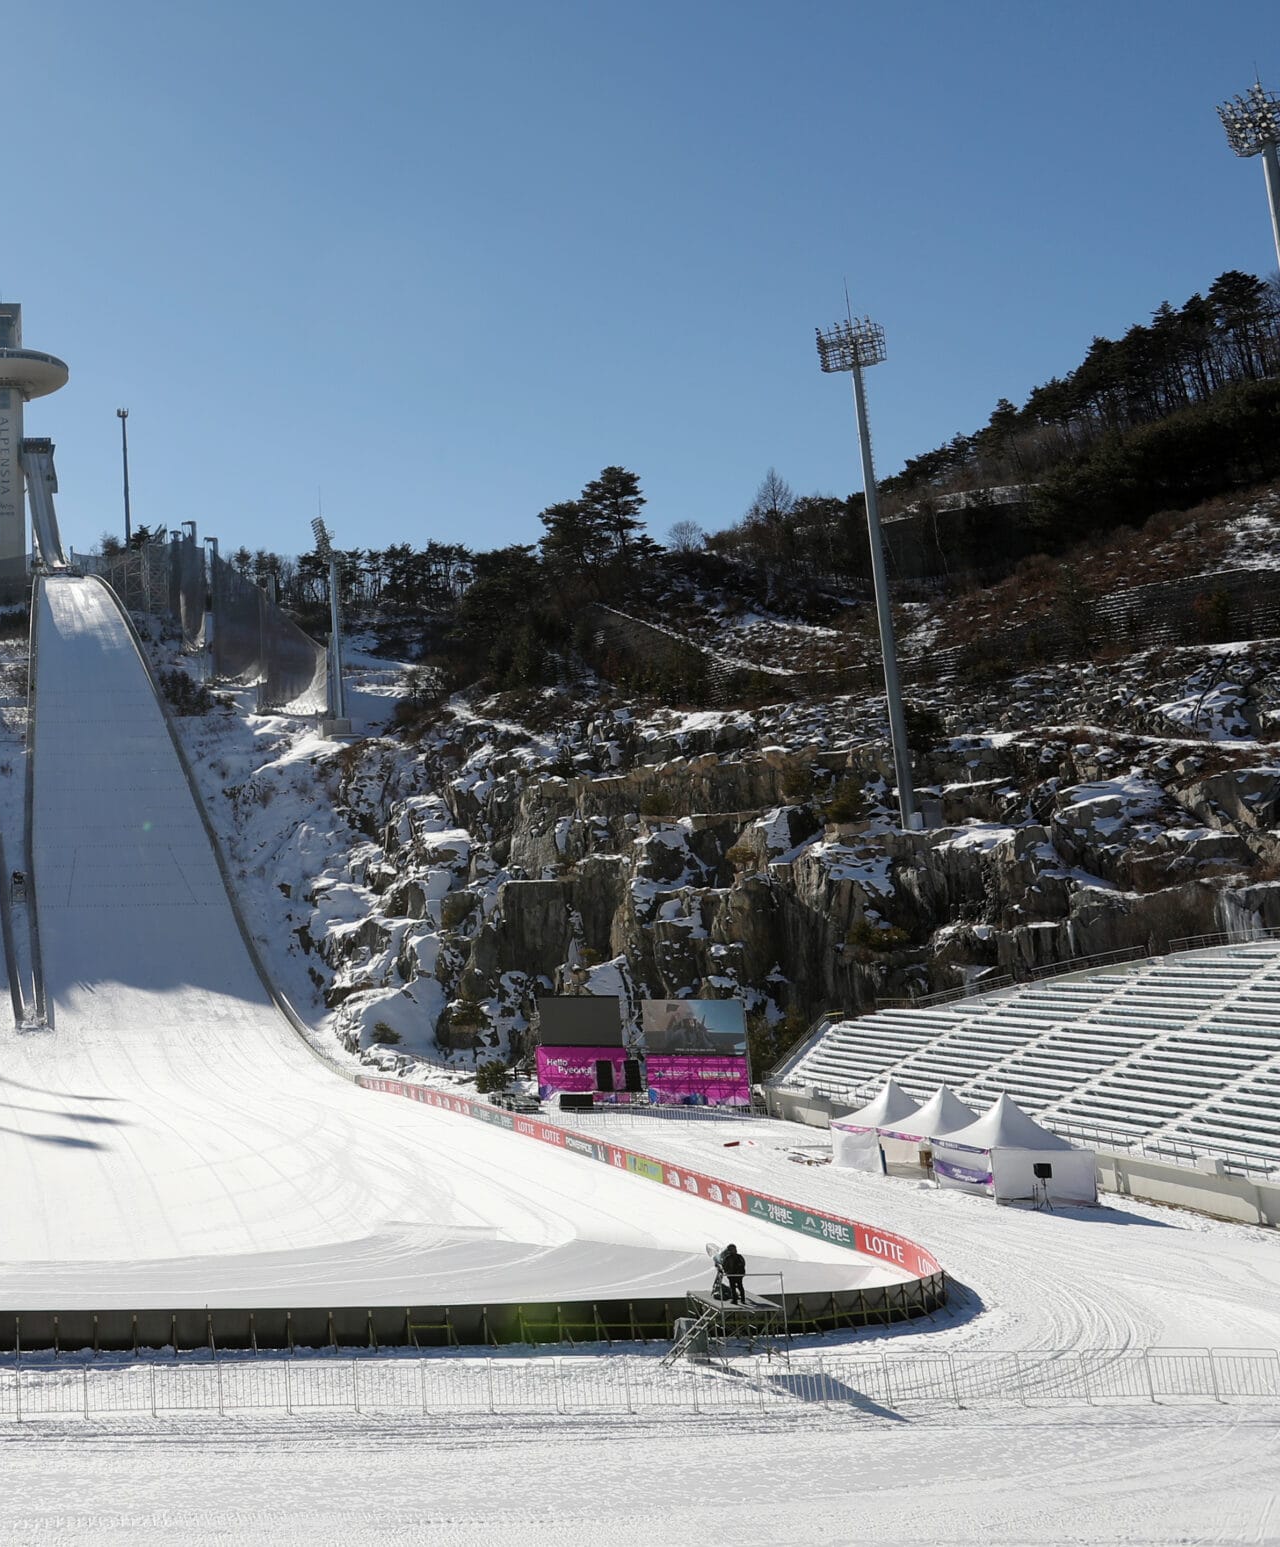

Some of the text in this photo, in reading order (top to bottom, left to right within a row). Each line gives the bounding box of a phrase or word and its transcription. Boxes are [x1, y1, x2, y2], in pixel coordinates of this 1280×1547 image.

[0, 417, 10, 495] ALPENSIA
[546, 1058, 568, 1067] Hello
[517, 1120, 535, 1136] LOTTE
[541, 1128, 561, 1144] LOTTE
[767, 1203, 794, 1225] 강원랜드
[820, 1220, 851, 1243] 강원랜드
[864, 1233, 905, 1264] LOTTE
